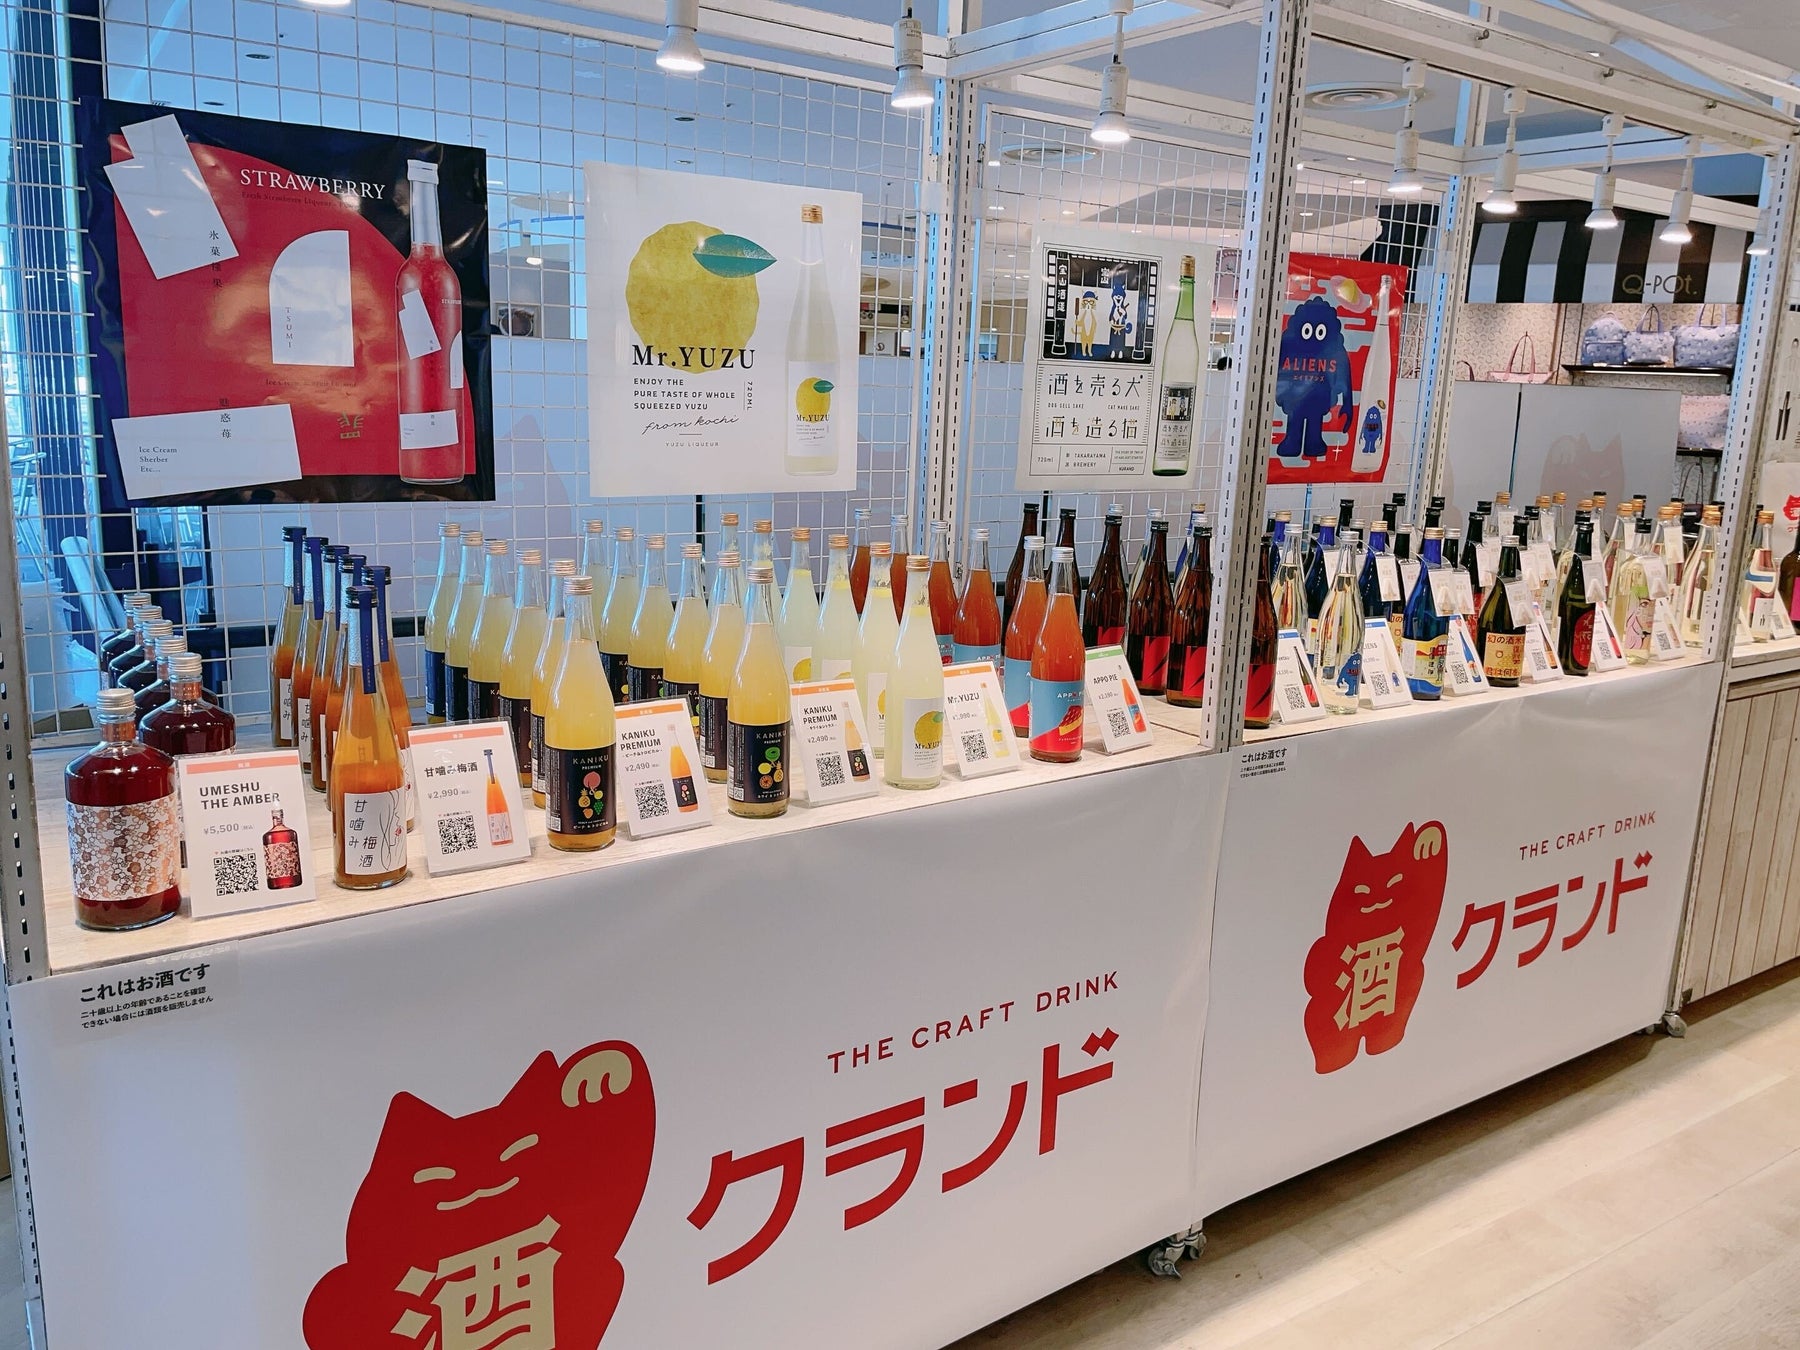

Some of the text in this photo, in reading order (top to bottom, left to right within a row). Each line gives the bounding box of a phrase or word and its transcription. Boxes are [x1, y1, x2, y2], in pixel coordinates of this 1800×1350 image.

[240, 168, 386, 200] STRAWBERRY
[632, 343, 756, 370] Mr.YUZU
[1281, 357, 1337, 373] ALIENS
[634, 378, 684, 386] ENJOY THE
[1048, 373, 1143, 397] 酒を売る犬
[661, 390, 688, 398] TASTE
[706, 391, 735, 399] WHOLE
[634, 402, 682, 410] SQUEEZED
[642, 421, 691, 436] from
[1045, 416, 1138, 439] 酒を造る猫
[803, 705, 832, 715] KANIKU
[802, 713, 838, 725] PREMIUM
[621, 728, 656, 741] KANIKU
[756, 729, 787, 739] KANIKU
[620, 738, 661, 751] PREMIUM
[572, 754, 609, 765] KANIKU
[1241, 747, 1287, 763] これはお酒です
[424, 761, 478, 778] 甘噛み梅酒
[625, 762, 650, 772] ¥2,490
[199, 781, 260, 797] UMESHU
[427, 788, 459, 800] ¥2,990
[201, 792, 280, 810] THE AMBER
[203, 822, 240, 835] ¥5,500
[1519, 811, 1657, 861] THE CRAFT DRINK
[1451, 850, 1653, 989] クランド
[80, 963, 211, 1002] これはお酒です
[1333, 926, 1405, 1031] 酒
[827, 971, 1120, 1074] THE CRAFT DRINK
[686, 1027, 1120, 1286] クランド
